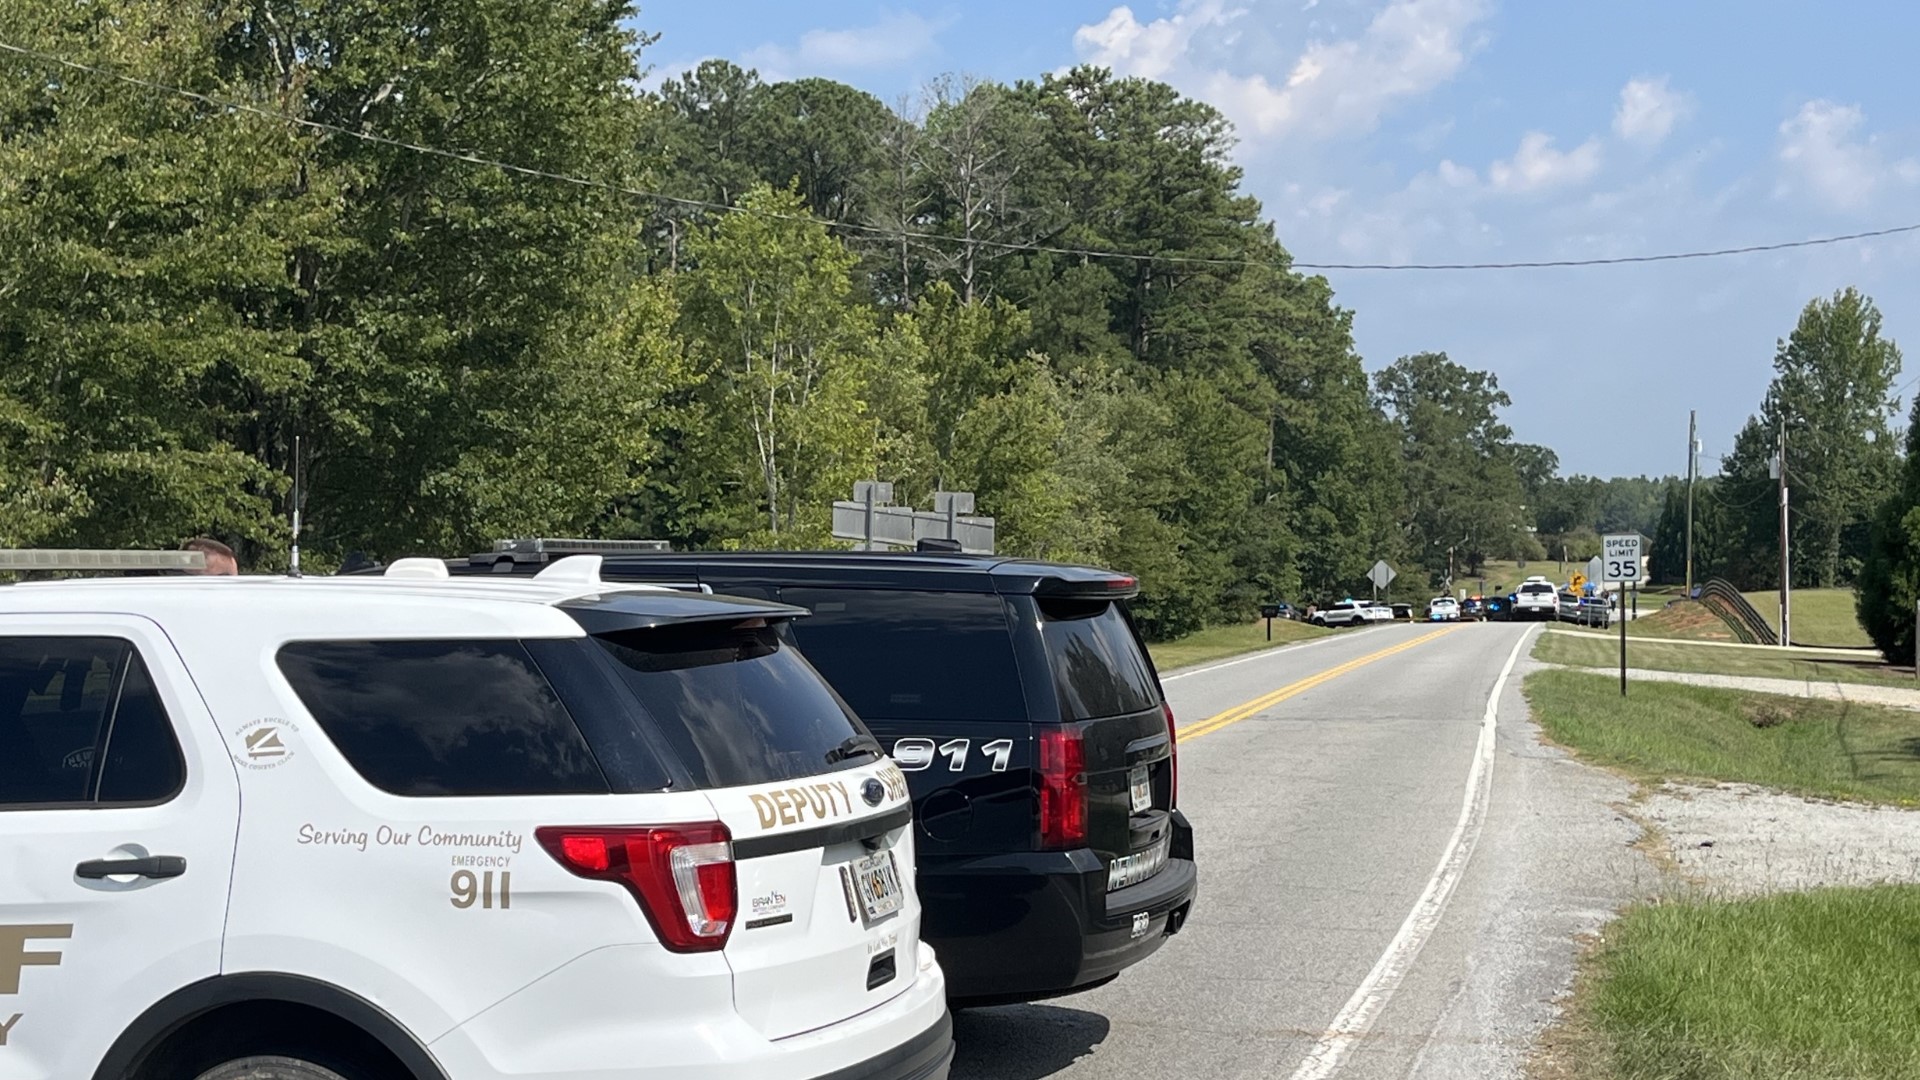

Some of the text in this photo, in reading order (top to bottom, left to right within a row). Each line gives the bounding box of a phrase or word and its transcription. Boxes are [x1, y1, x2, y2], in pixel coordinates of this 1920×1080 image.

[1606, 539, 1638, 548] SPEED
[1609, 549, 1634, 557] LIMIT
[1608, 561, 1636, 577] 35
[893, 737, 1013, 772] 911
[748, 781, 853, 830] DEPUTY
[297, 823, 523, 854] Serving Our Community
[451, 855, 511, 867] EMERGENCY
[450, 870, 511, 909] 911
